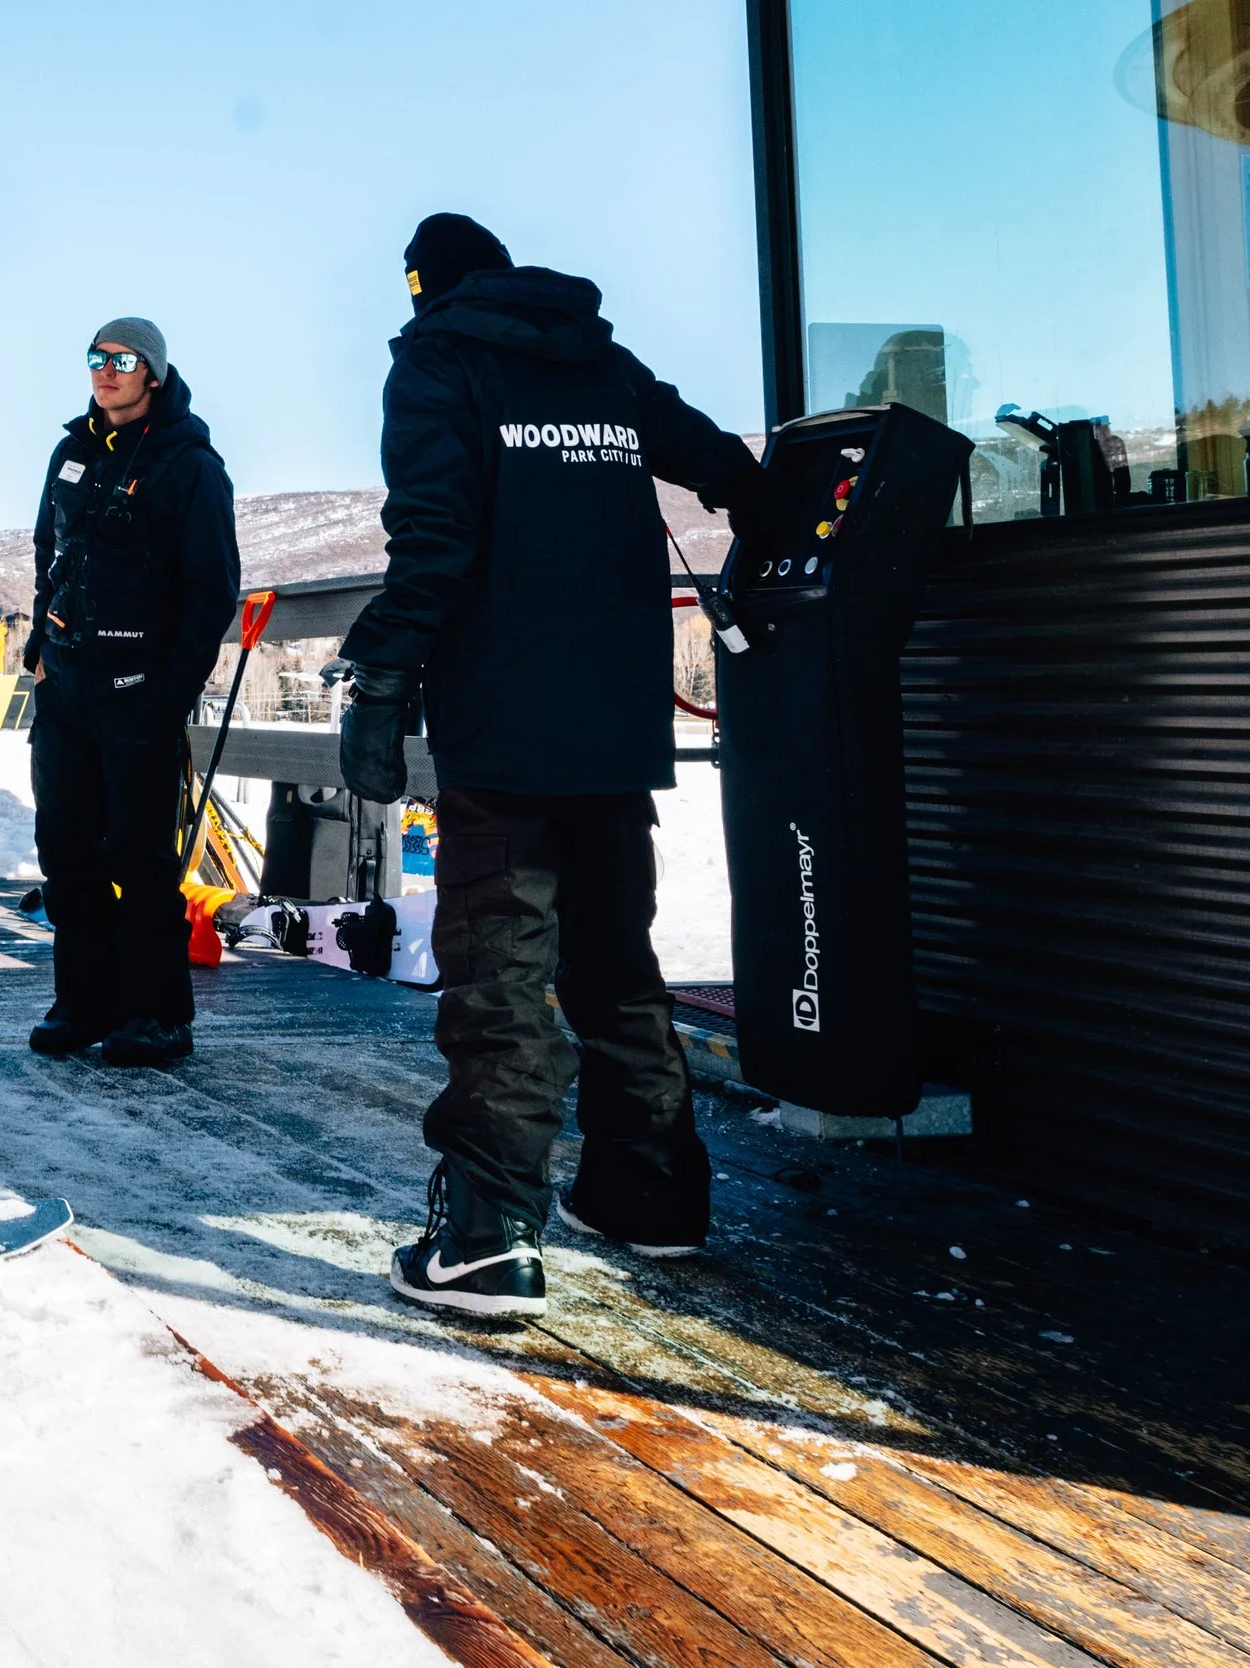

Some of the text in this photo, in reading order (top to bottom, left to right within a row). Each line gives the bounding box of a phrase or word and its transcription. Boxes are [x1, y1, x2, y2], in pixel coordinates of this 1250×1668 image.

[499, 424, 639, 451] WOODWARD
[561, 450, 597, 463] PARK
[600, 449, 624, 463] CITY
[630, 454, 642, 467] UT
[98, 630, 144, 638] MAMMUT
